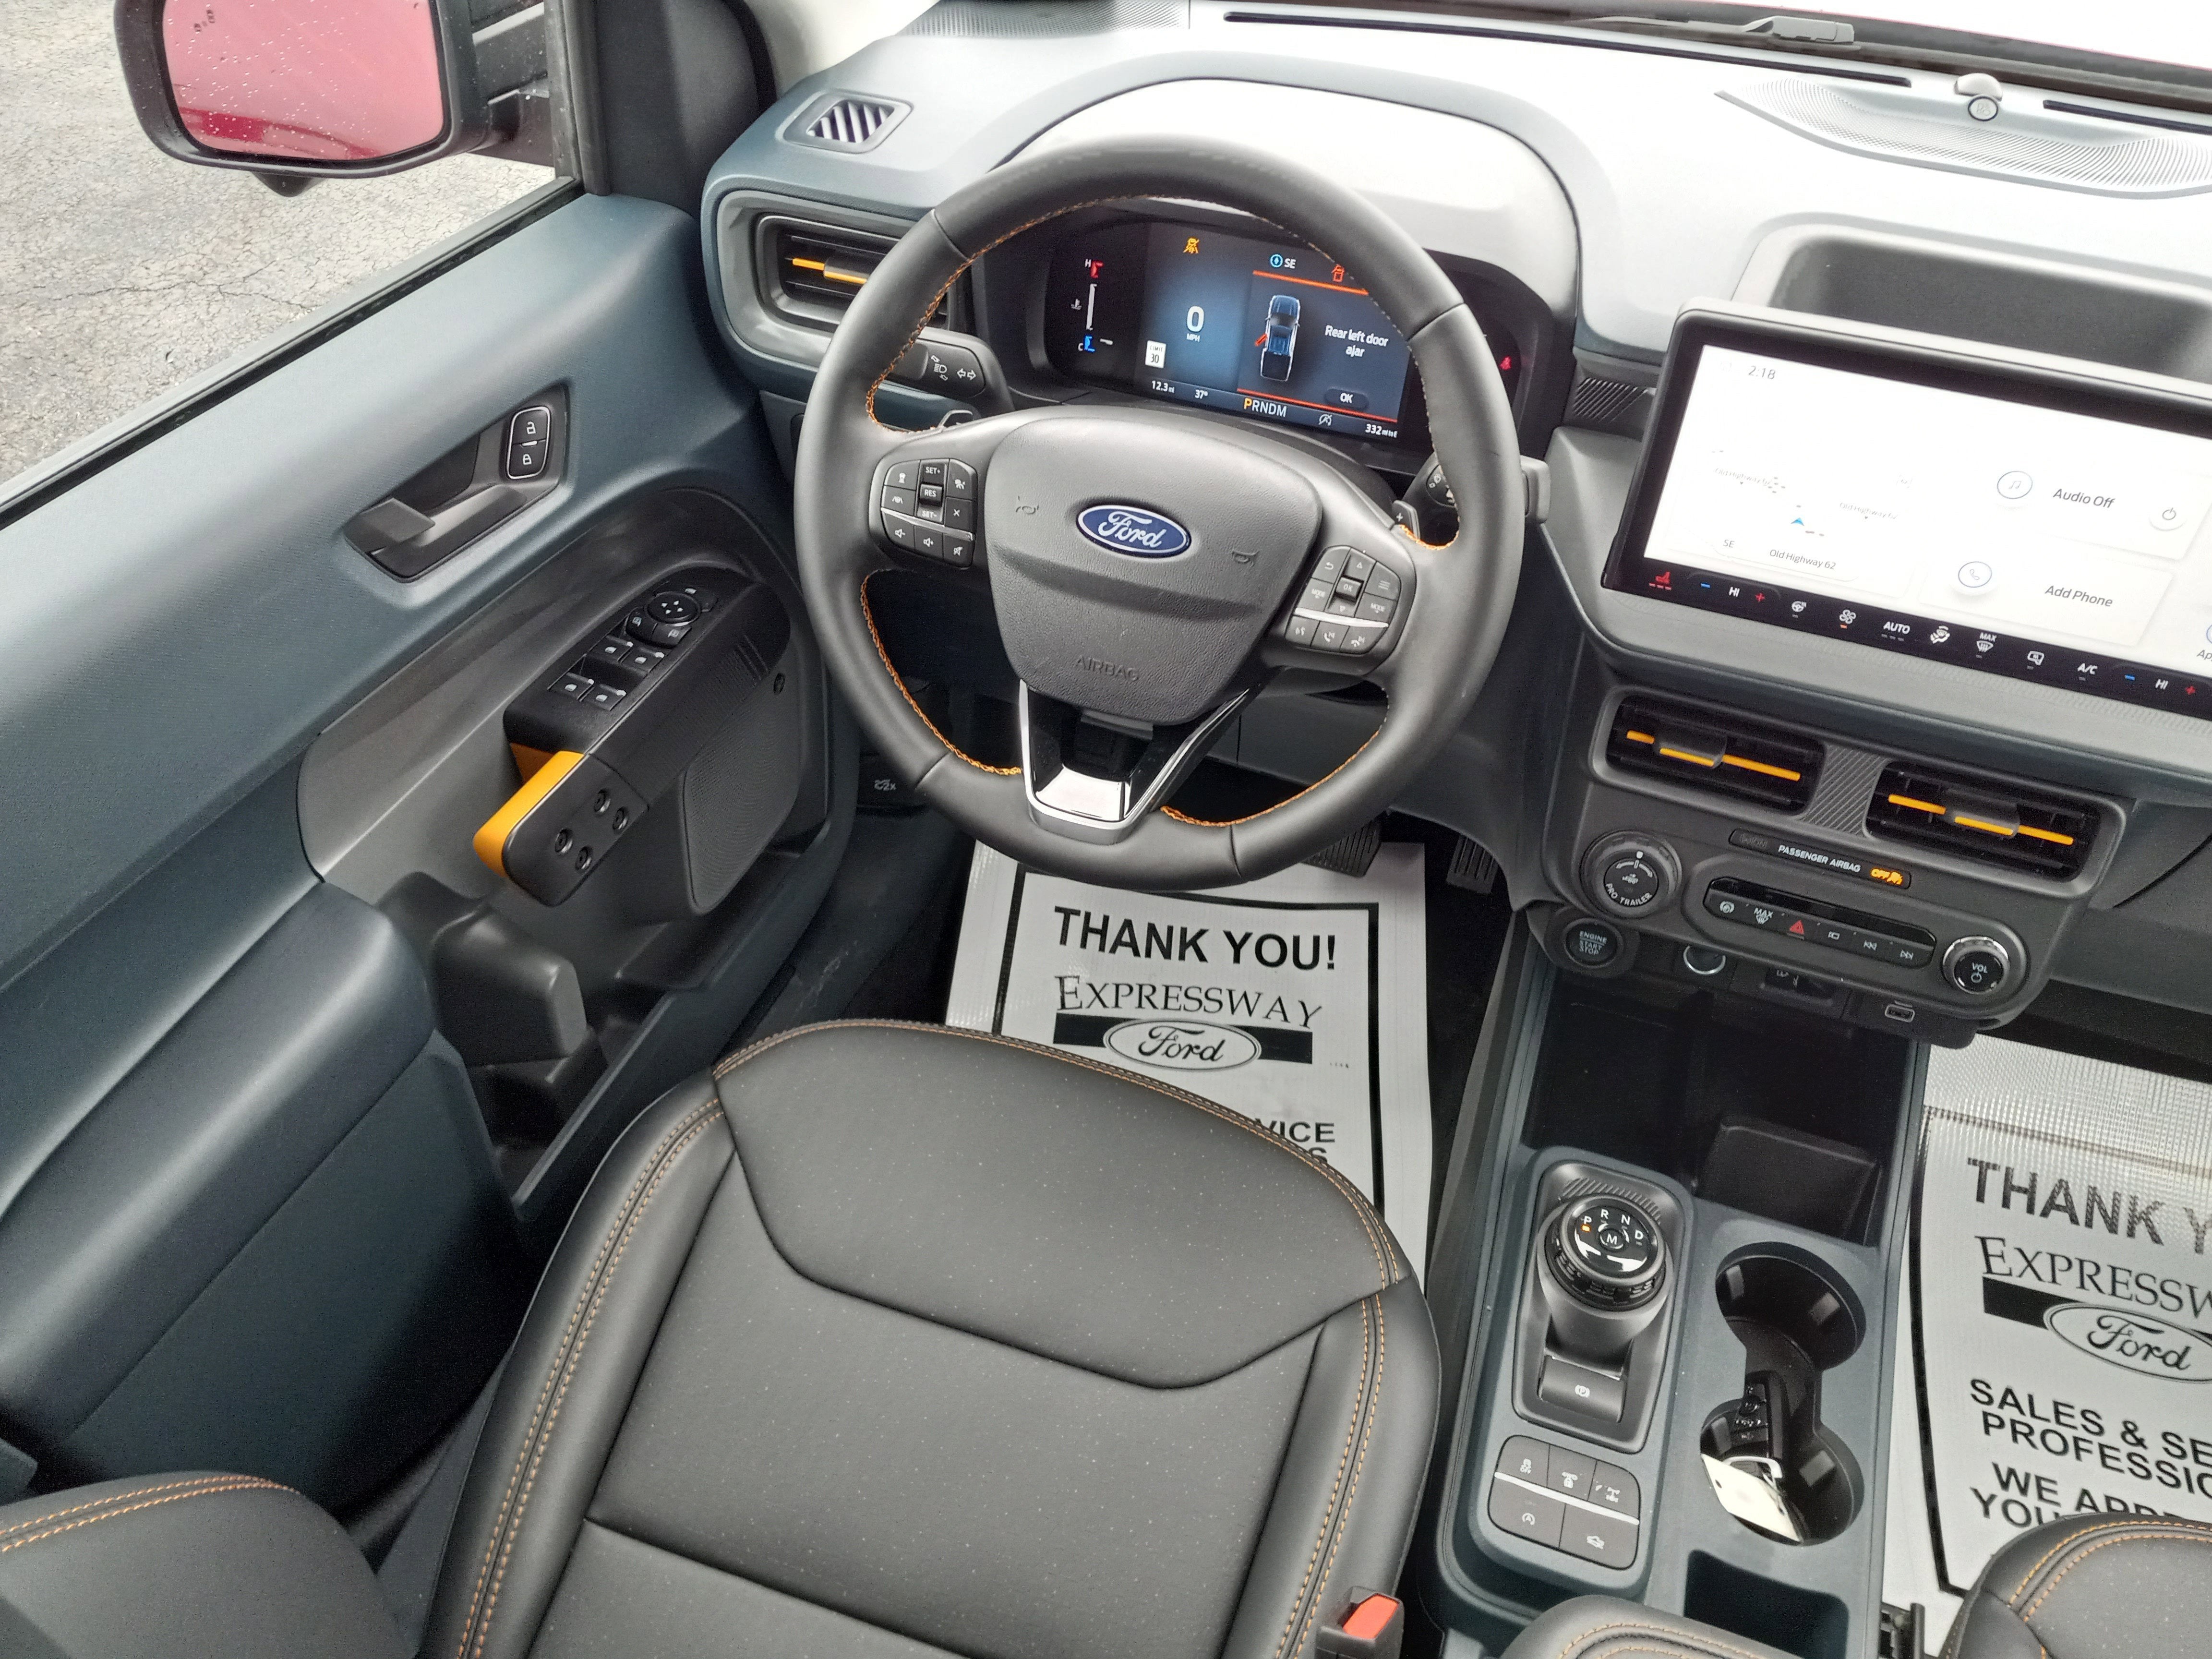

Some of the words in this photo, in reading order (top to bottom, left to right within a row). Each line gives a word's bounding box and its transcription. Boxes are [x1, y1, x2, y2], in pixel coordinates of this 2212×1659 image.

[1085, 259, 1092, 268] H
[1284, 258, 1296, 269] SE
[1187, 306, 1204, 332] 0
[1186, 333, 1200, 342] MPH
[1325, 325, 1347, 339] Rear
[1348, 329, 1365, 343] left
[1366, 334, 1389, 347] door
[1078, 343, 1083, 351] C
[1346, 345, 1365, 357] ajar
[1151, 353, 1159, 363] 30
[1748, 365, 1776, 380] 2:18
[1152, 380, 1168, 392] 12.3
[1340, 393, 1353, 404] OK
[1365, 423, 1382, 435] 332
[924, 489, 937, 498] RES
[2053, 489, 2091, 504] Audio
[2093, 496, 2116, 508] Off
[1098, 510, 1162, 548] Ford
[1723, 539, 1735, 548] SE
[1769, 549, 1785, 559] Old
[1786, 553, 1823, 568] Highway
[1824, 561, 1836, 570] 62
[1311, 588, 1326, 598] MODE
[1344, 584, 1353, 592] OK
[1728, 587, 1740, 597] HI
[2044, 585, 2070, 599] Add
[2071, 590, 2113, 607] Phone
[1370, 602, 1386, 613] MODE
[1883, 621, 1911, 635] AUTO
[1980, 632, 1997, 642] MAX
[1074, 655, 1139, 682] AIRBAG
[2077, 663, 2098, 674] A/C
[2155, 679, 2168, 690] HI
[1778, 844, 1828, 865] PASSENGER
[1829, 858, 1861, 873] AIRBAG
[1870, 868, 1889, 878] OFF
[1605, 883, 1618, 899] PRO
[1620, 892, 1653, 906] TRAILER
[1753, 907, 1774, 918] MAX
[1054, 905, 1210, 963] THANK
[1222, 929, 1336, 970] YOU!
[1579, 930, 1608, 944] ENGINE
[1972, 962, 1988, 974] VOL
[1055, 975, 1322, 1029] EXPRESSWAY
[1138, 1025, 1224, 1062] Ford
[1967, 1157, 2164, 1246] THANK
[1584, 1215, 1592, 1224] P
[1600, 1209, 1609, 1219] R
[1621, 1214, 1630, 1225] N
[1606, 1234, 1617, 1245] M
[1635, 1229, 1644, 1240] D
[2087, 1314, 2192, 1372] Ford
[1970, 1378, 2105, 1437] SALES
[2120, 1420, 2149, 1450] &
[1992, 1462, 2061, 1507] WE
